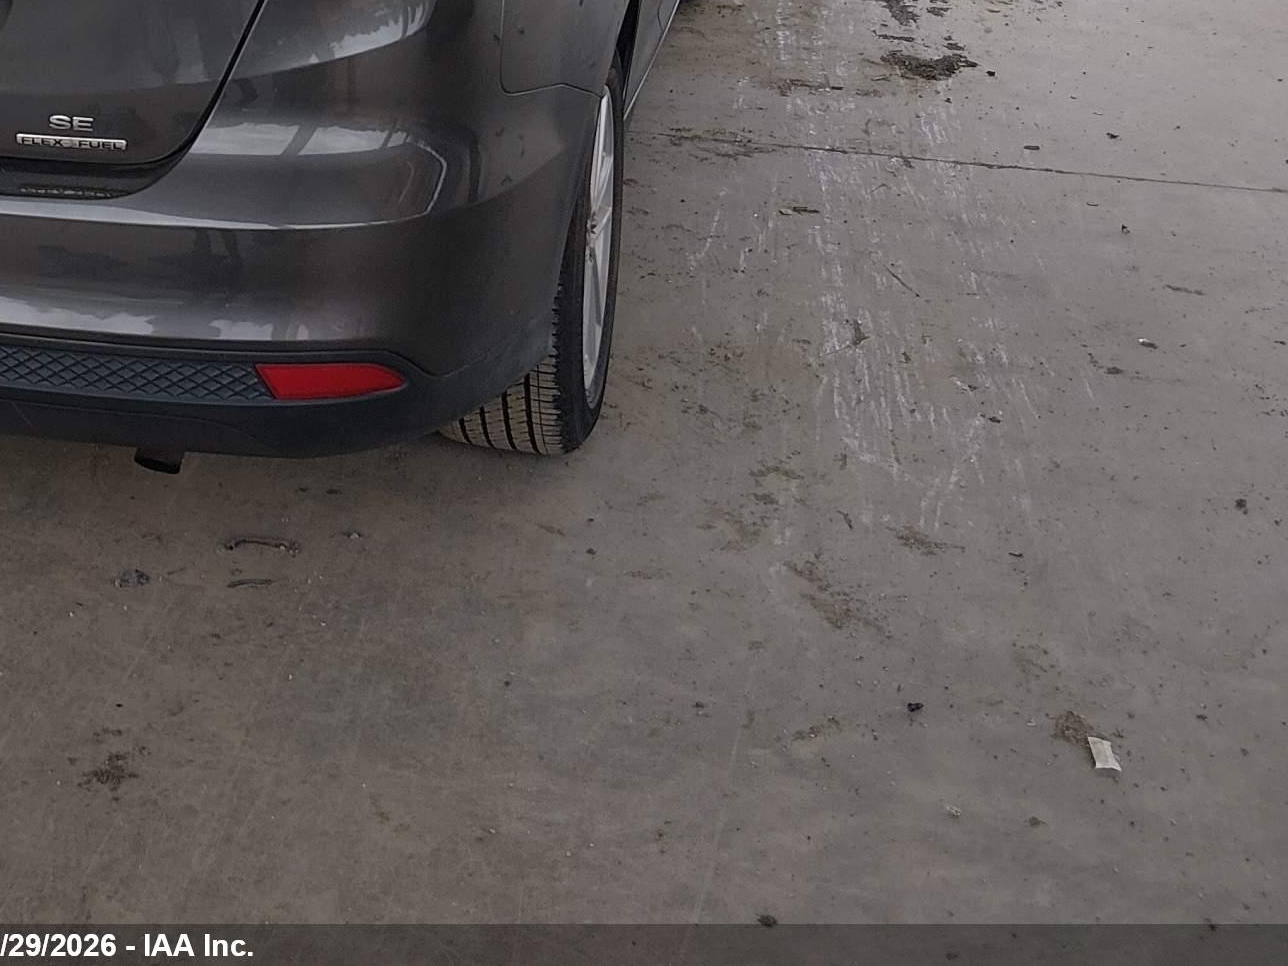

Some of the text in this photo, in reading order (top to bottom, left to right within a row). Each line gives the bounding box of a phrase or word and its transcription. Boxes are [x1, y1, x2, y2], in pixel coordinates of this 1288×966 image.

[49, 115, 94, 132] SE
[22, 136, 123, 150] FLEX FUEL
